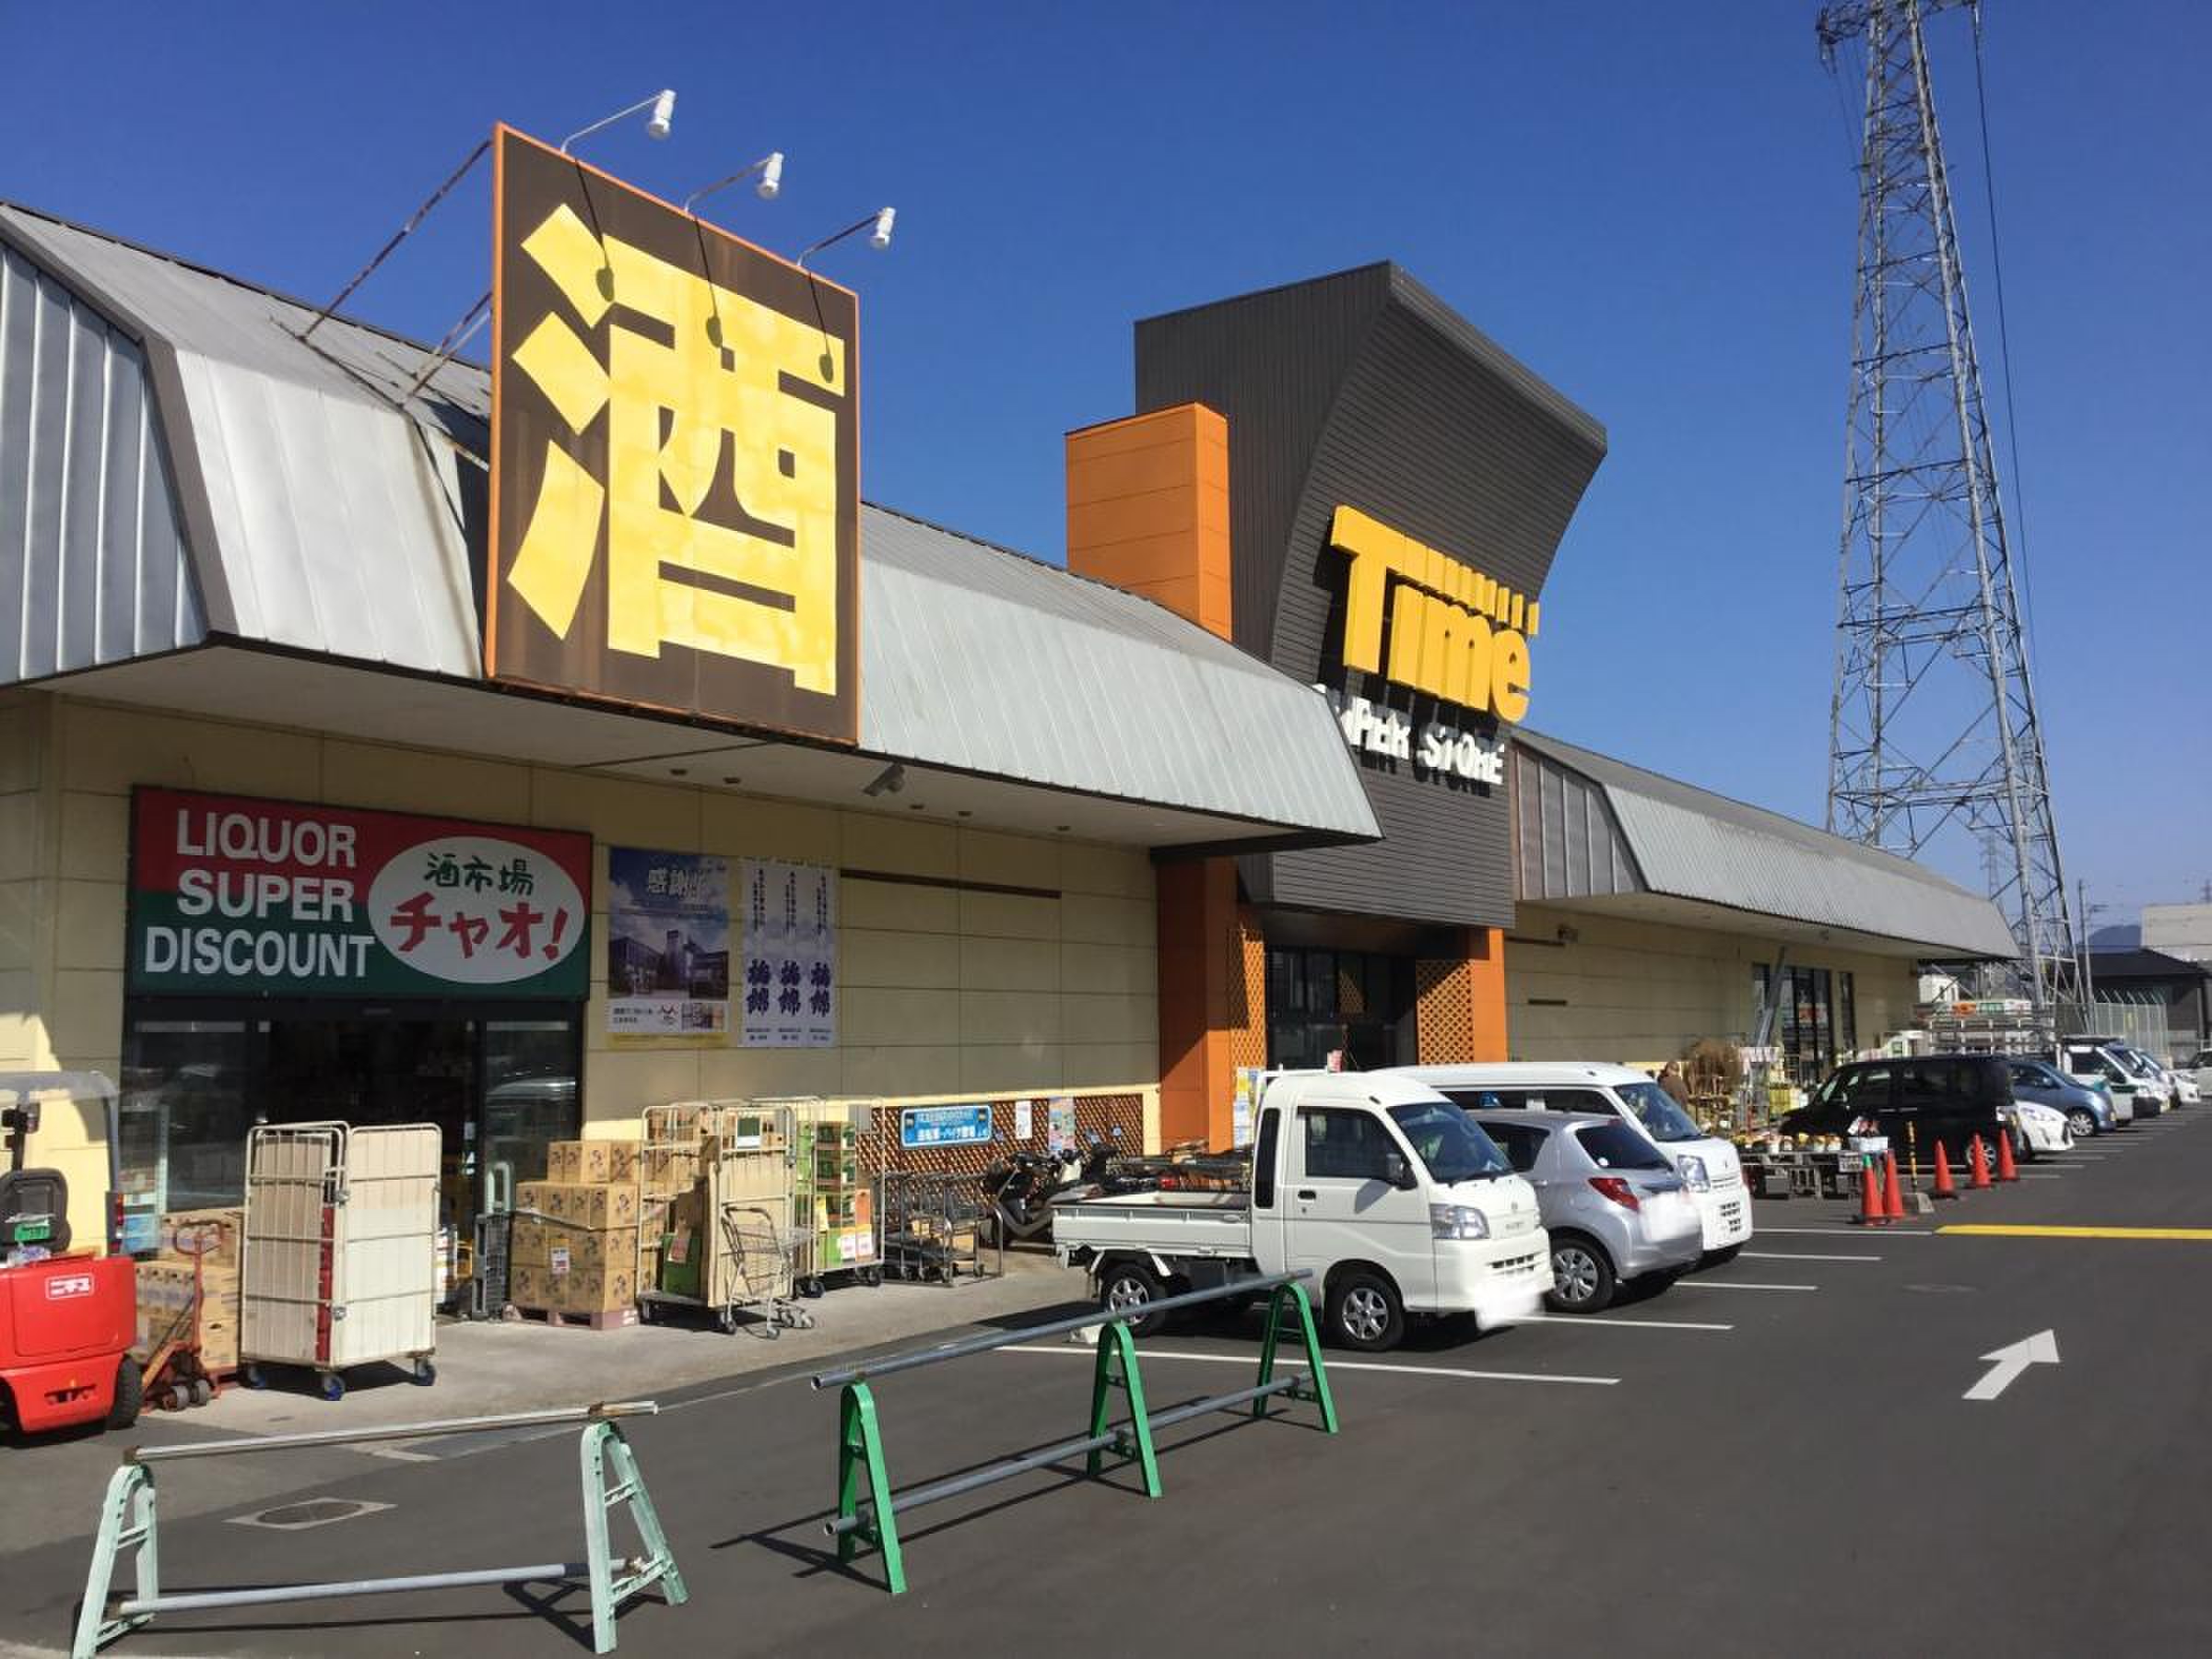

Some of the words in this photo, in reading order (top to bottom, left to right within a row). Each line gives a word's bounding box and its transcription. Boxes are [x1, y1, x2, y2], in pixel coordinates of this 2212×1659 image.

[508, 203, 844, 696] 酒
[1330, 504, 1539, 724] Time
[177, 809, 357, 868] LIQUOR
[177, 869, 355, 922] SUPER
[423, 853, 535, 896] 酒市場
[145, 926, 375, 977] DISCOUNT
[390, 891, 568, 960] チャオ!
